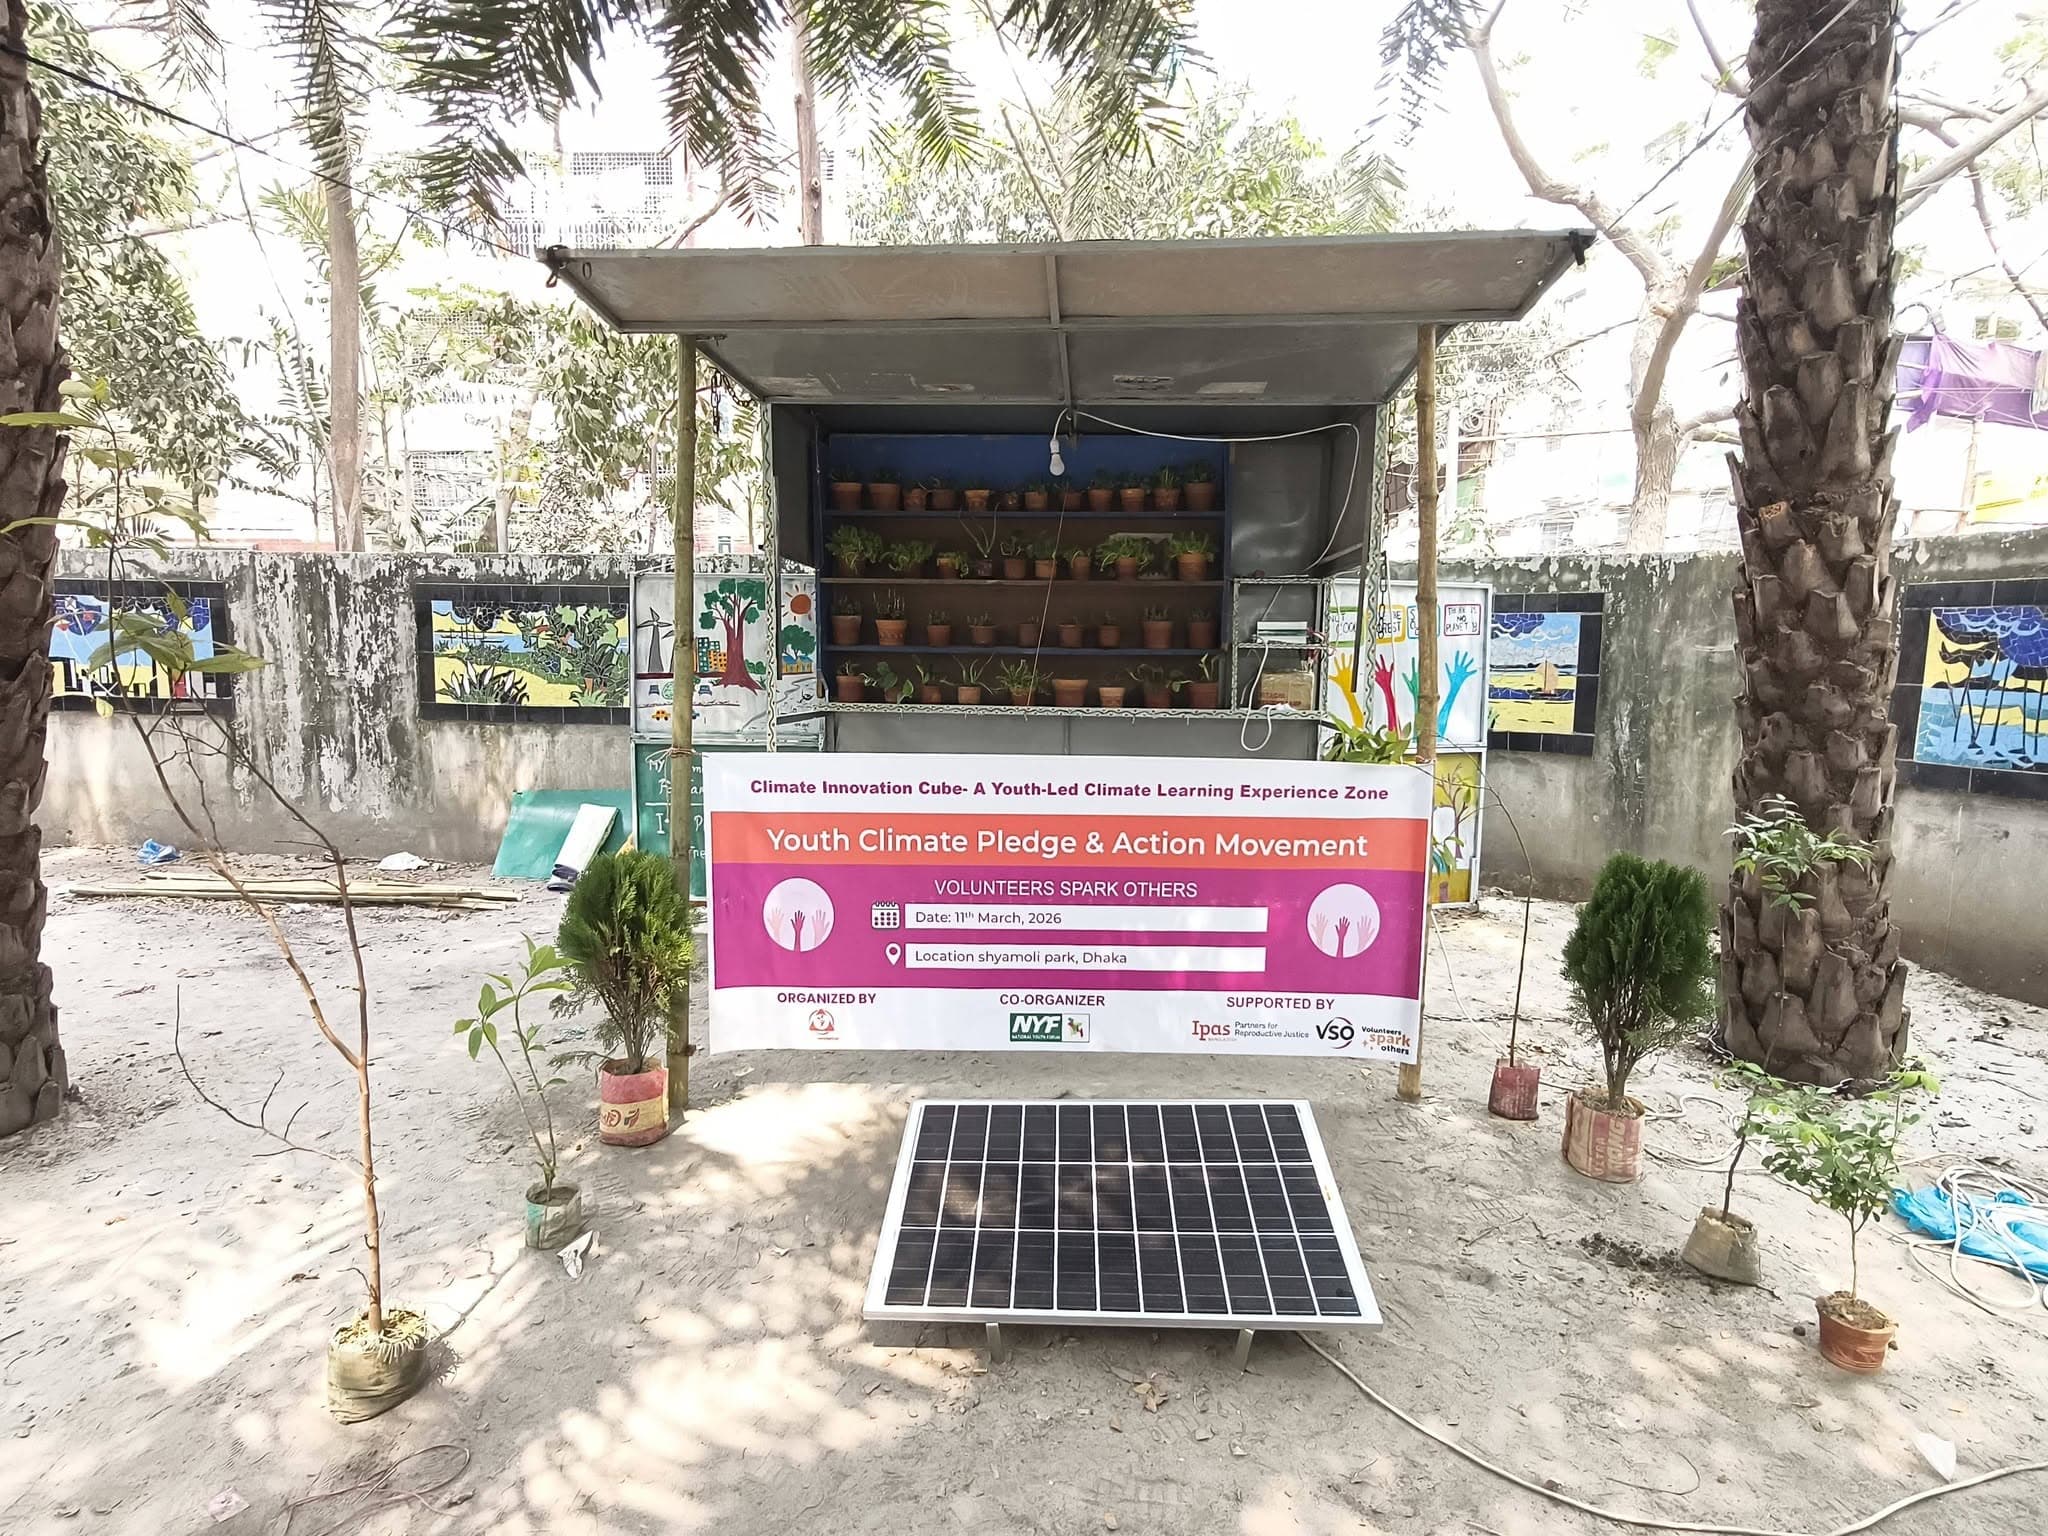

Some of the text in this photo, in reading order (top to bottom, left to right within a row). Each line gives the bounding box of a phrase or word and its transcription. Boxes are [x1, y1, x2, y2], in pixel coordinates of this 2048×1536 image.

[750, 780, 1389, 801] Climate Innovation Cube- A Youth-Led Climate Learning Experience Zone
[766, 827, 1368, 859] Youth Climate Pledge & Action Movement
[934, 880, 1198, 898] VOLUNTEERS SPARK OTHERS
[915, 911, 1062, 926] Date: 11th March, 2026
[915, 950, 1127, 966] Location shyamoli park, Dhaka
[777, 992, 876, 1005] ORGANIZED BY
[1000, 994, 1105, 1007] CO-ORGANIZER
[1226, 996, 1335, 1011] SUPPORTED BY
[1012, 1015, 1061, 1034] NYF
[1192, 1020, 1231, 1040] Ipas
[1234, 1021, 1278, 1029] Partners for
[1316, 1020, 1355, 1041] VSO
[1361, 1026, 1402, 1035] Volunteers
[1234, 1029, 1309, 1038] Reproductive Justice
[1369, 1033, 1411, 1047] spark
[1380, 1045, 1409, 1055] others
